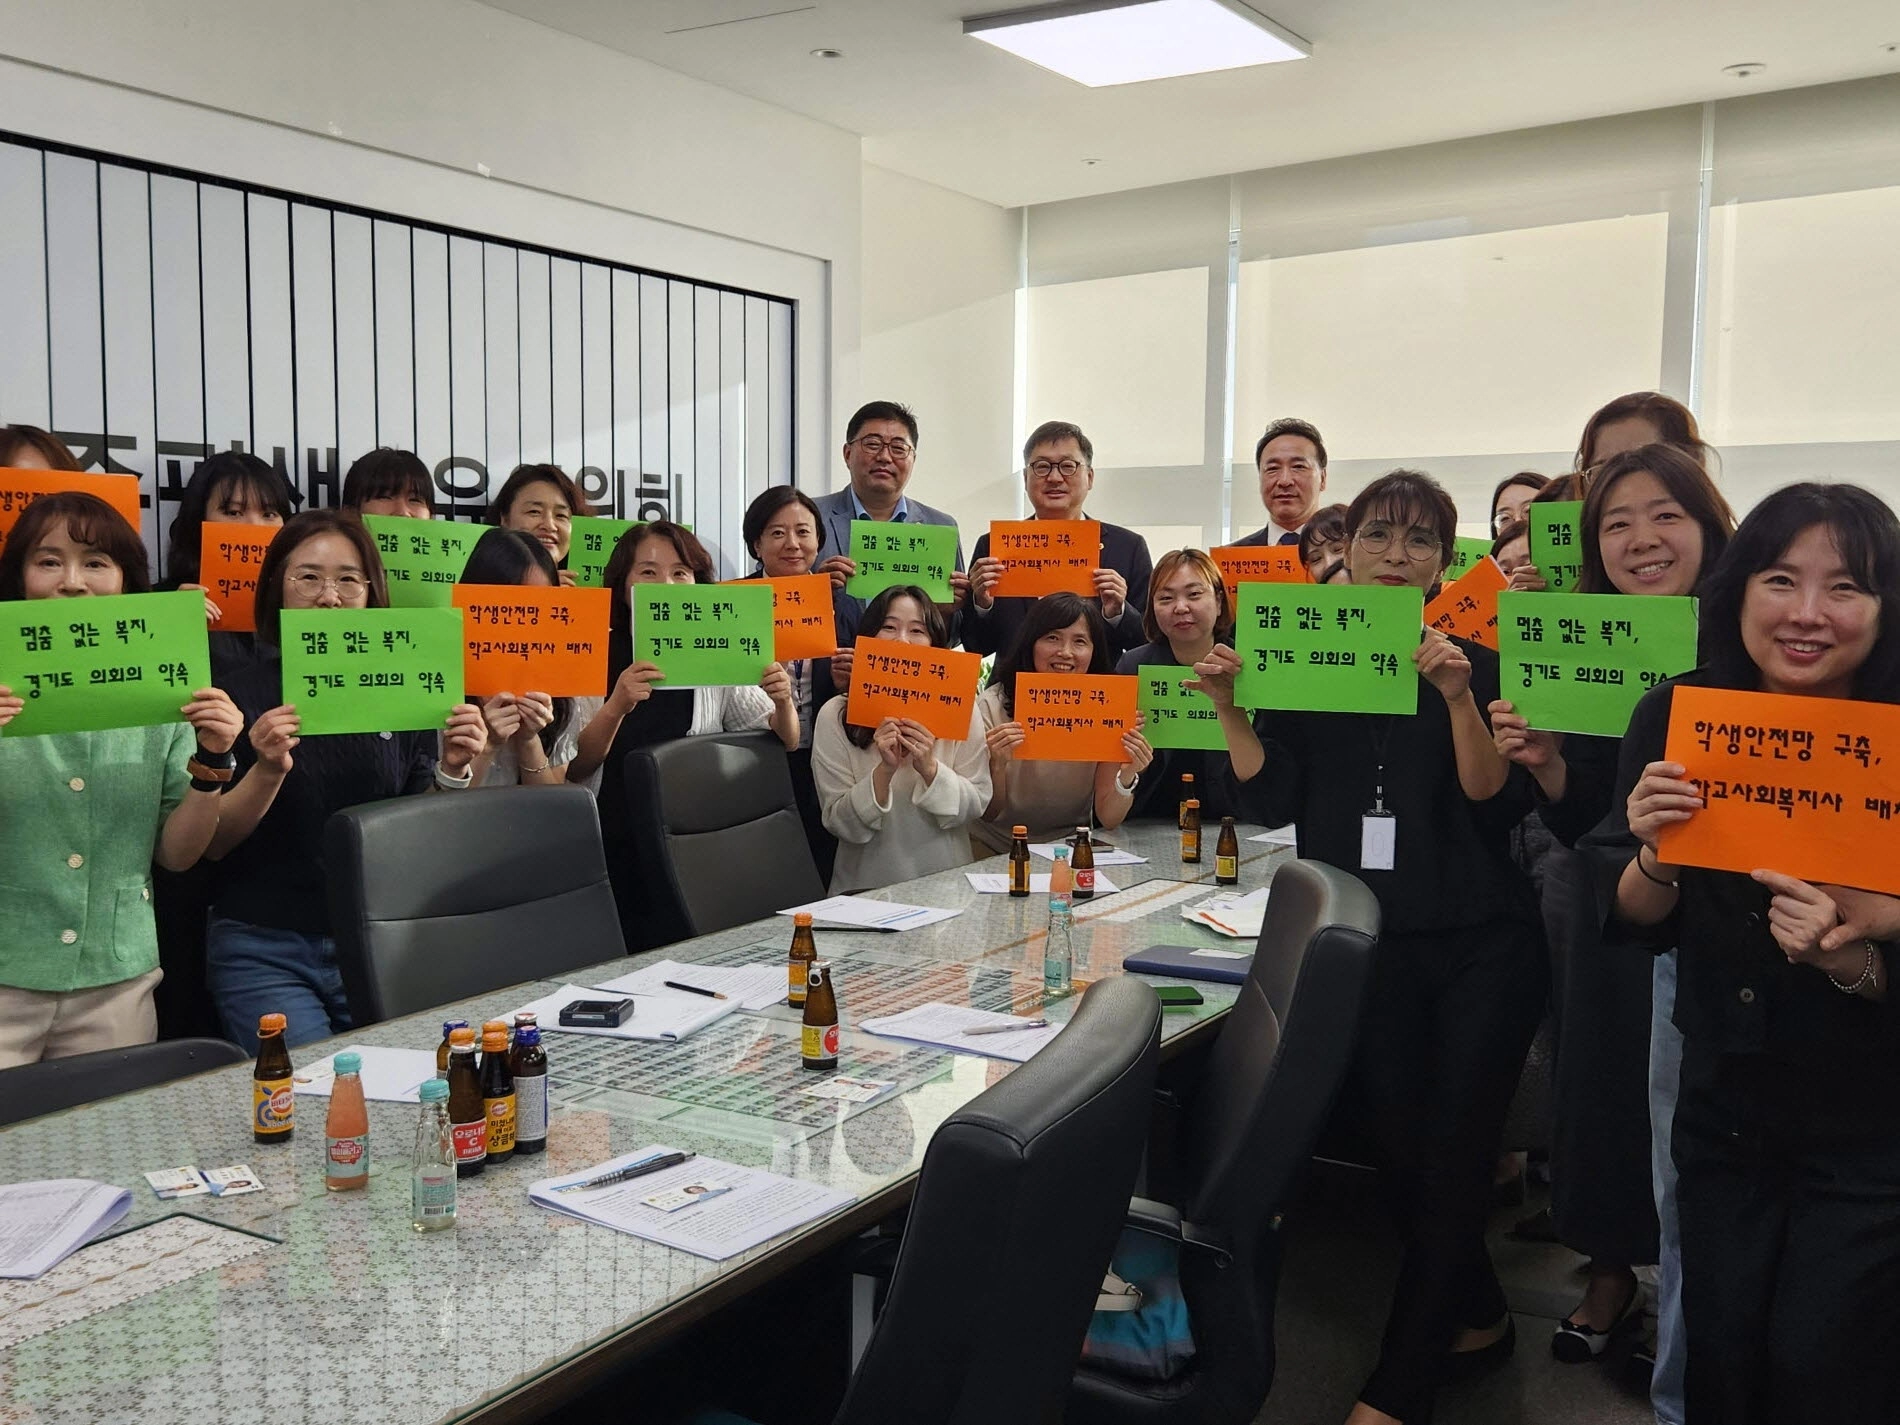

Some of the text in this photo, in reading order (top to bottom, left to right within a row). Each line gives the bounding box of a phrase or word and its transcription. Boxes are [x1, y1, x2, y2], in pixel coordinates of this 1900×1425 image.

[584, 534, 602, 551] 멈춤
[862, 535, 928, 552] 멈춤 없는 복지,
[1002, 534, 1074, 547] 학생안전망 구축,
[1548, 523, 1572, 545] 멈춤
[377, 534, 466, 556] 멈춤 없는 복지,
[860, 562, 943, 580] 경기도 의회의 약속
[1222, 560, 1295, 574] 학생안전망 구축,
[421, 571, 455, 584] 의회의
[786, 591, 804, 605] 구축,
[1456, 596, 1481, 613] 구축,
[470, 605, 576, 625] 학생안전망 구축,
[650, 602, 737, 621] 멈춤 없는 복지,
[802, 617, 821, 625] 배치
[1256, 606, 1371, 631] 멈춤 없는 복지,
[20, 619, 153, 651] 멈춤 없는 복지,
[1517, 617, 1638, 646] 멈춤 없는 복지,
[302, 631, 416, 654] 멈춤 없는 복지,
[469, 642, 591, 661] 학교사회복지사 배치
[650, 638, 760, 656] 경기도 의회의 약속
[868, 654, 949, 679] 학생안전망 구축,
[1254, 649, 1398, 676] 경기도 의회의 약속
[24, 663, 188, 699] 경기도 의회의 약속
[303, 672, 444, 697] 경기도 의회의 약속
[1519, 663, 1560, 687] 경기도
[1575, 667, 1623, 685] 의회의
[863, 683, 961, 706] 학교사회복지사 배치
[1029, 689, 1109, 704] 학생안전망 구축,
[1151, 681, 1168, 696] 멈춤
[1028, 717, 1123, 732] 학교사회복지사 배치
[1150, 709, 1217, 723] 경기도 의회의
[1695, 721, 1881, 768] 학생안전망 구축,
[1690, 779, 1843, 818] 학교사회복지사
[469, 1137, 478, 1146] C
